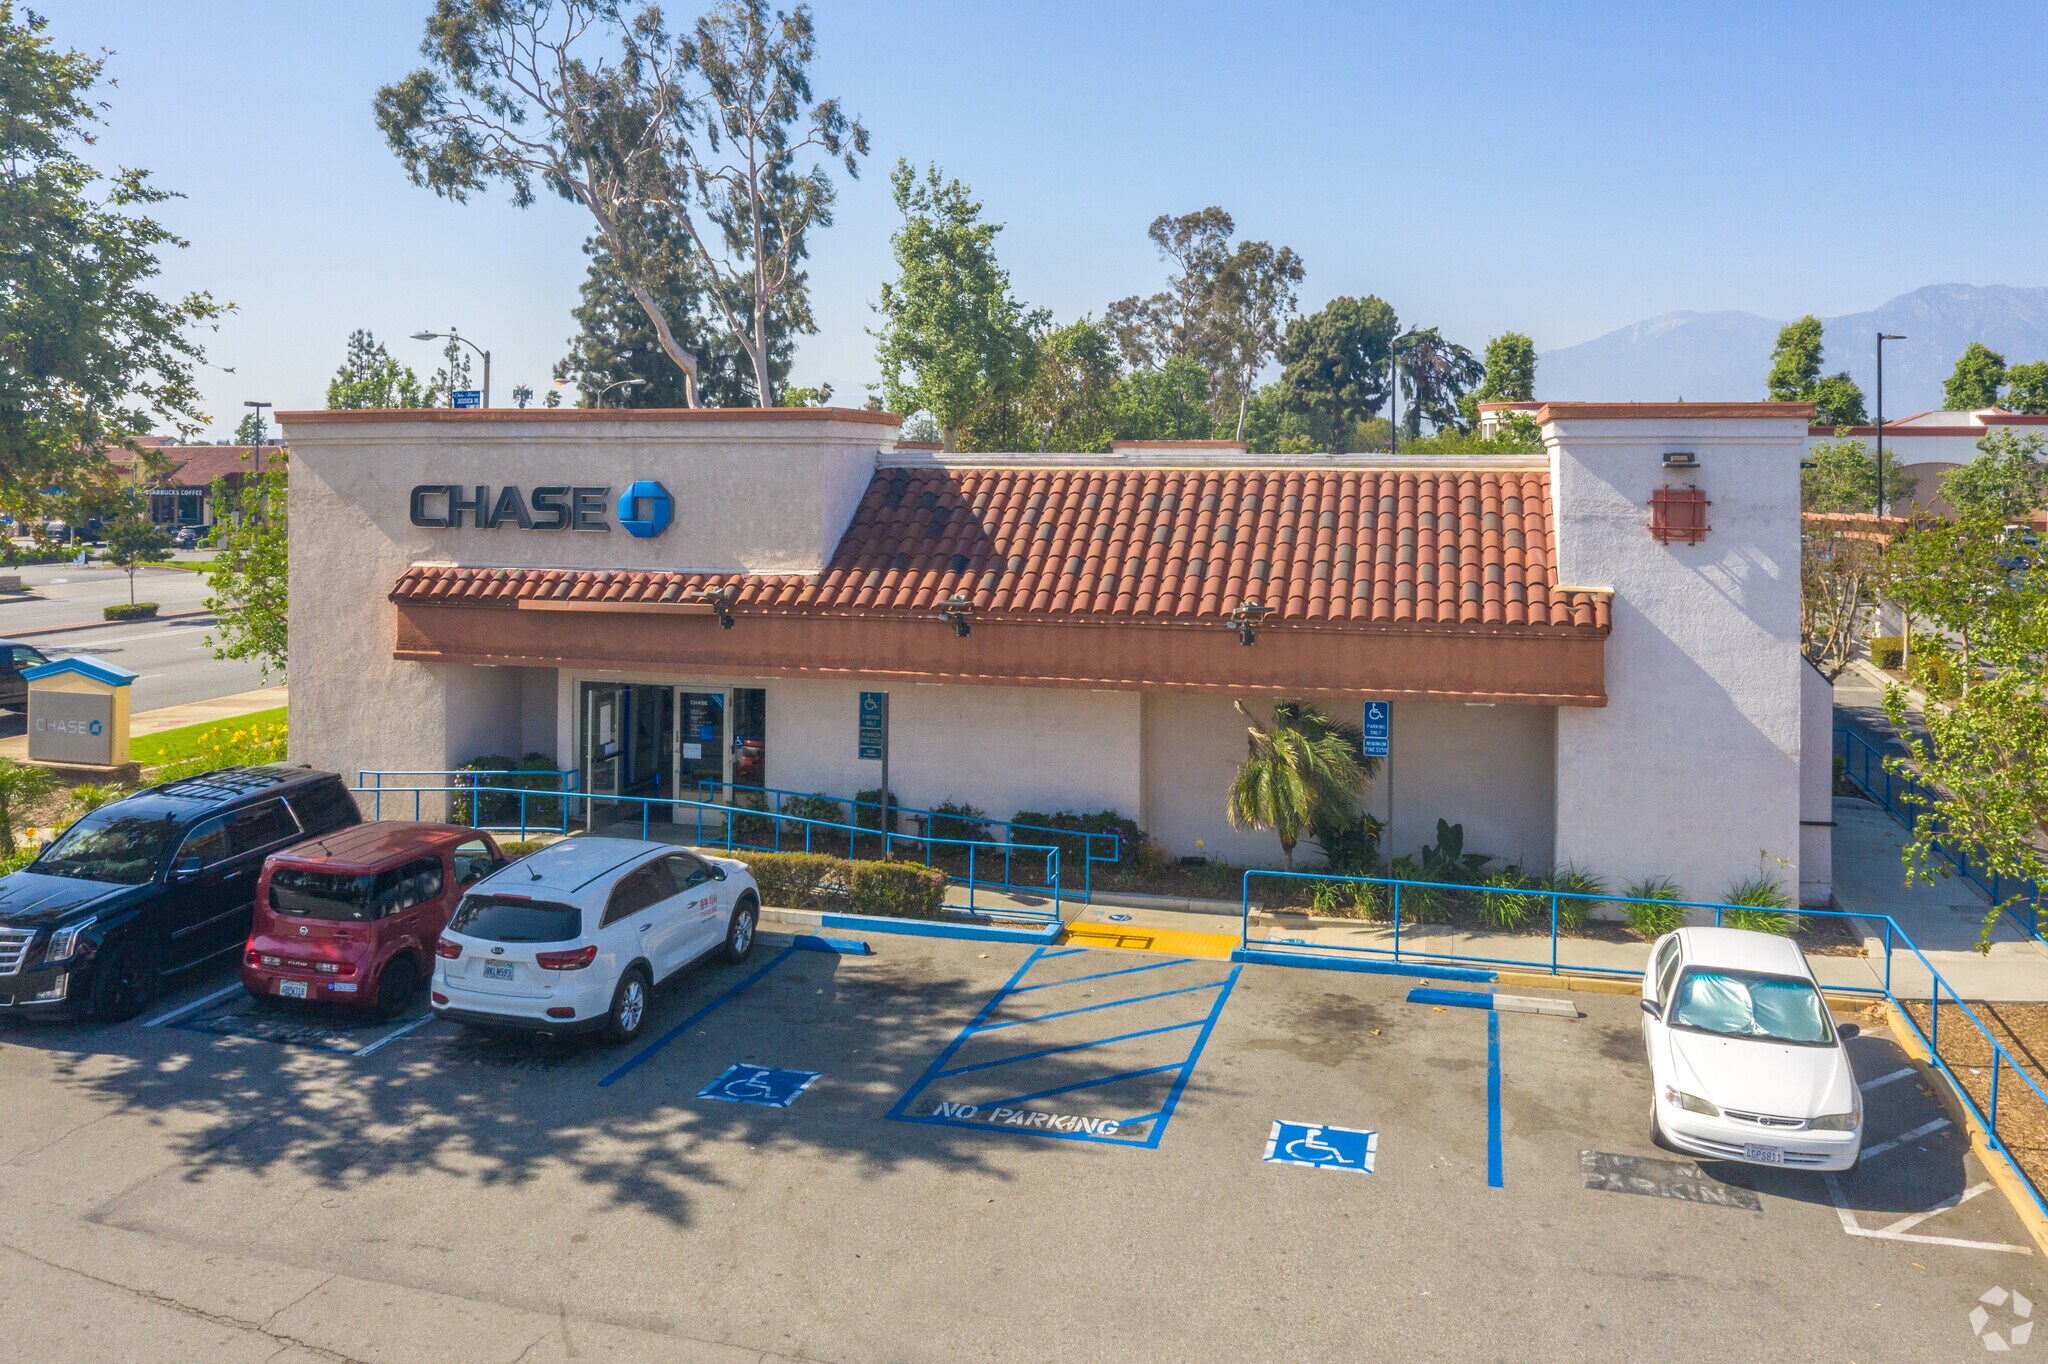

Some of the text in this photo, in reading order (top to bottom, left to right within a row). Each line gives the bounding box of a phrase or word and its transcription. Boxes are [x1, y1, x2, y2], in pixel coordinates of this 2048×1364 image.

[409, 484, 611, 532] CHASE
[35, 718, 87, 735] CHASE
[932, 1101, 1120, 1136] NO PARKING
